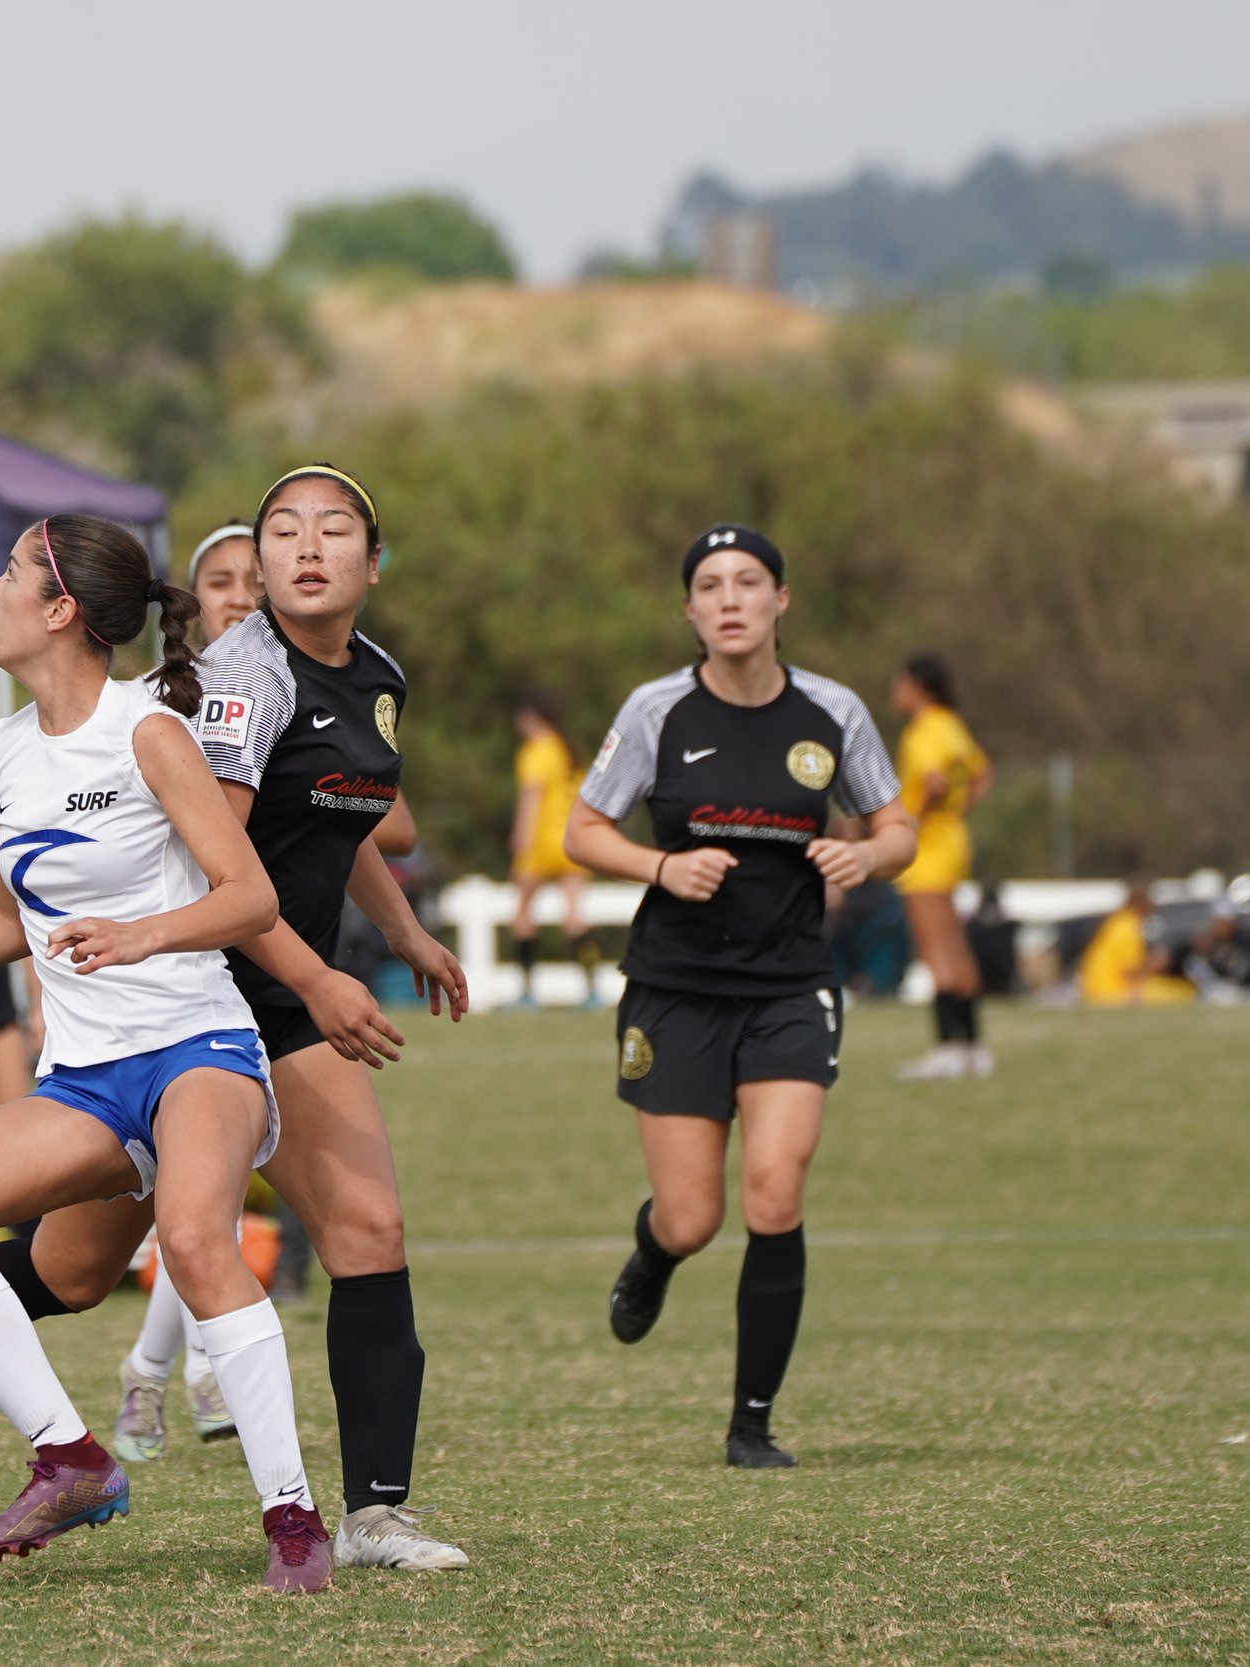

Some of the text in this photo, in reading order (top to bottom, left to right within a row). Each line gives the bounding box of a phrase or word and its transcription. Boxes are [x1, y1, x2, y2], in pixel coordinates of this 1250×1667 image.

[205, 700, 245, 724] DP
[203, 725, 240, 733] DEVELOPMENT
[221, 731, 239, 739] LEAGUE
[65, 791, 118, 812] SURF
